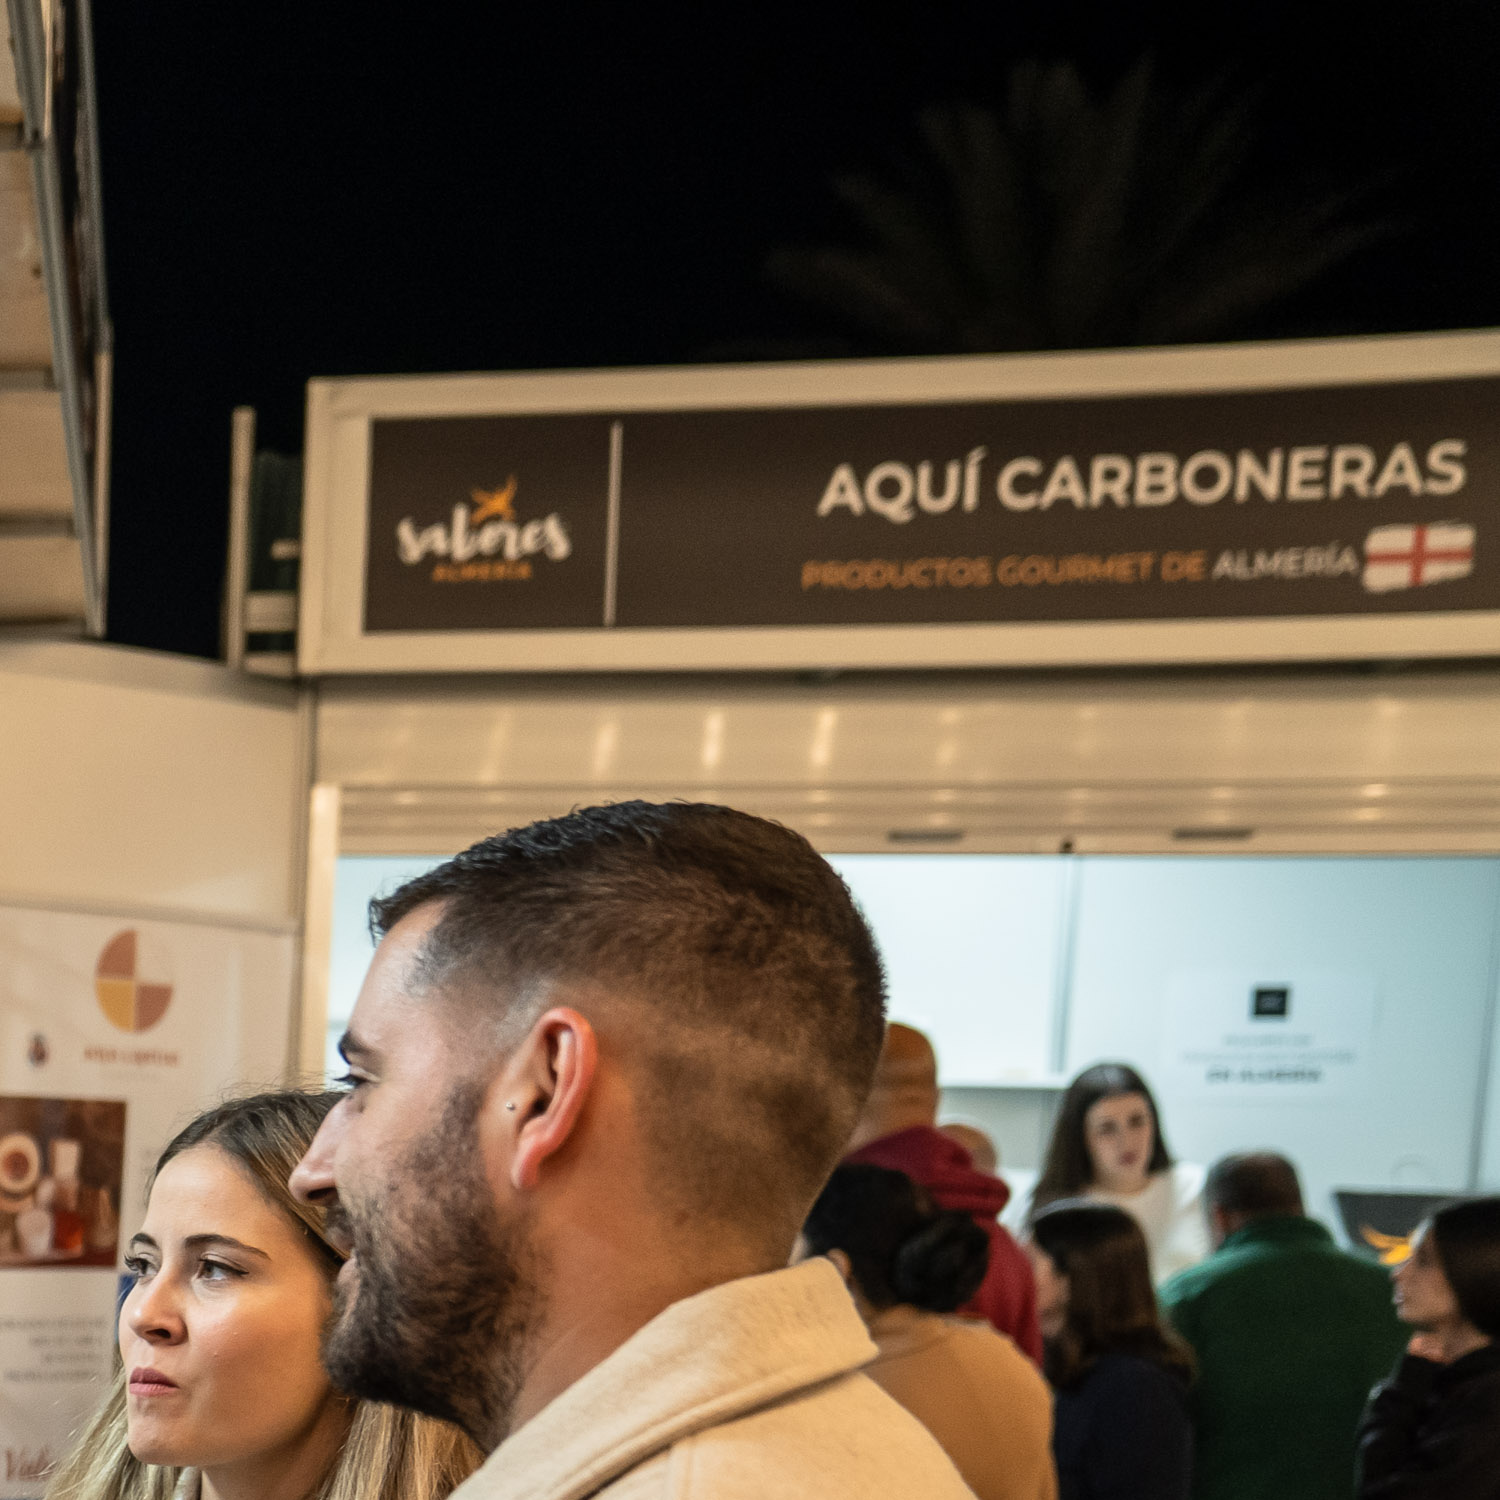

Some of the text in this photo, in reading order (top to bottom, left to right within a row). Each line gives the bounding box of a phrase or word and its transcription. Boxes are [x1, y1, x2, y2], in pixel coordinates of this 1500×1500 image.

[817, 439, 1468, 524] AQUÍ CARBONERAS
[802, 541, 1359, 590] PRODUCTOS GOURMET DE ALMERÍA
